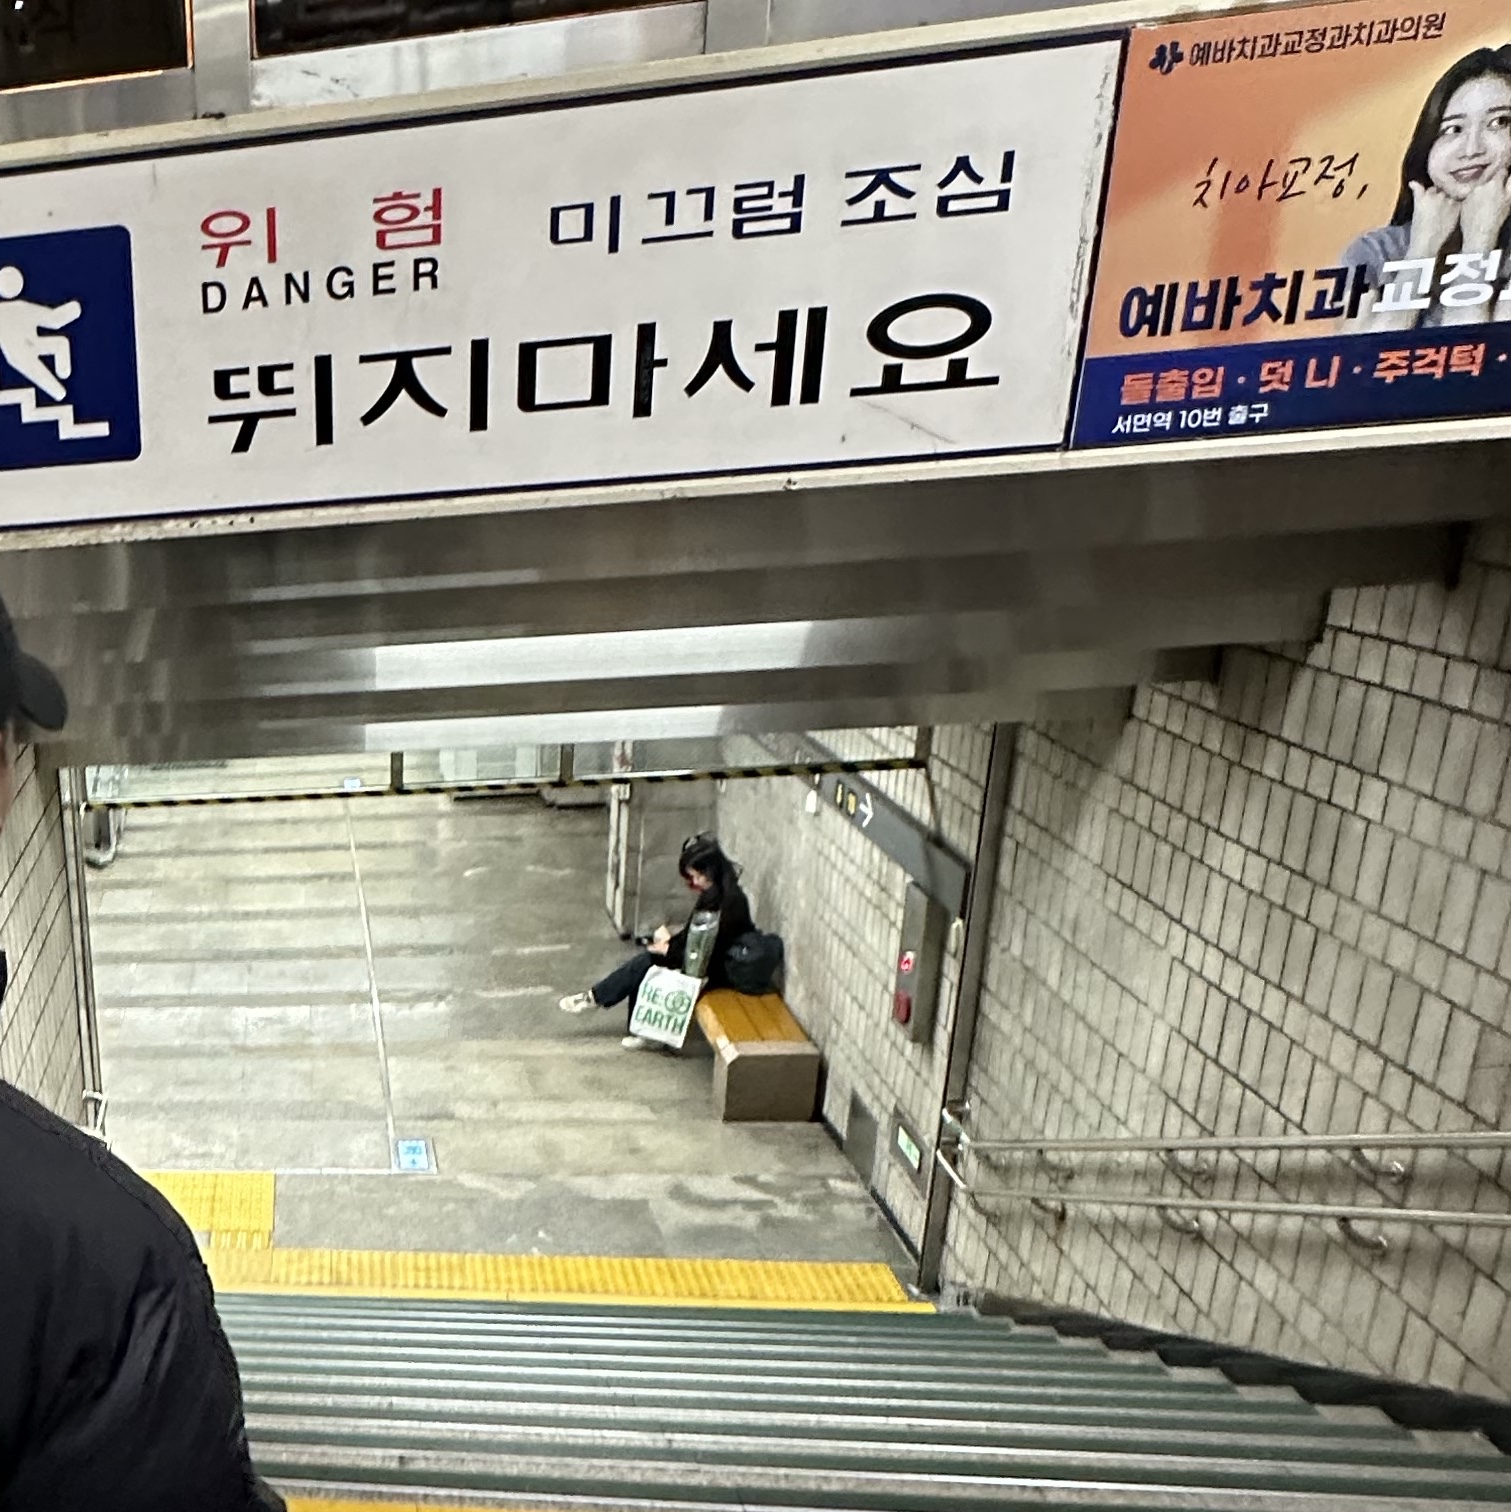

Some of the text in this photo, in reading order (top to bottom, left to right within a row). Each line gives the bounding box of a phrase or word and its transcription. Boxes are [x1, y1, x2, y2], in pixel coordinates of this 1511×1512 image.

[1189, 12, 1447, 66] 예바치과교정과치과의원
[550, 150, 1016, 254] 미끄럼 조심
[202, 257, 441, 314] DANGER
[1119, 249, 1511, 338] 예바치과교정
[207, 292, 1000, 453] 뛰지마세요
[1111, 402, 1269, 434] 서면역 10번 출구
[635, 1004, 687, 1035] EARTH
